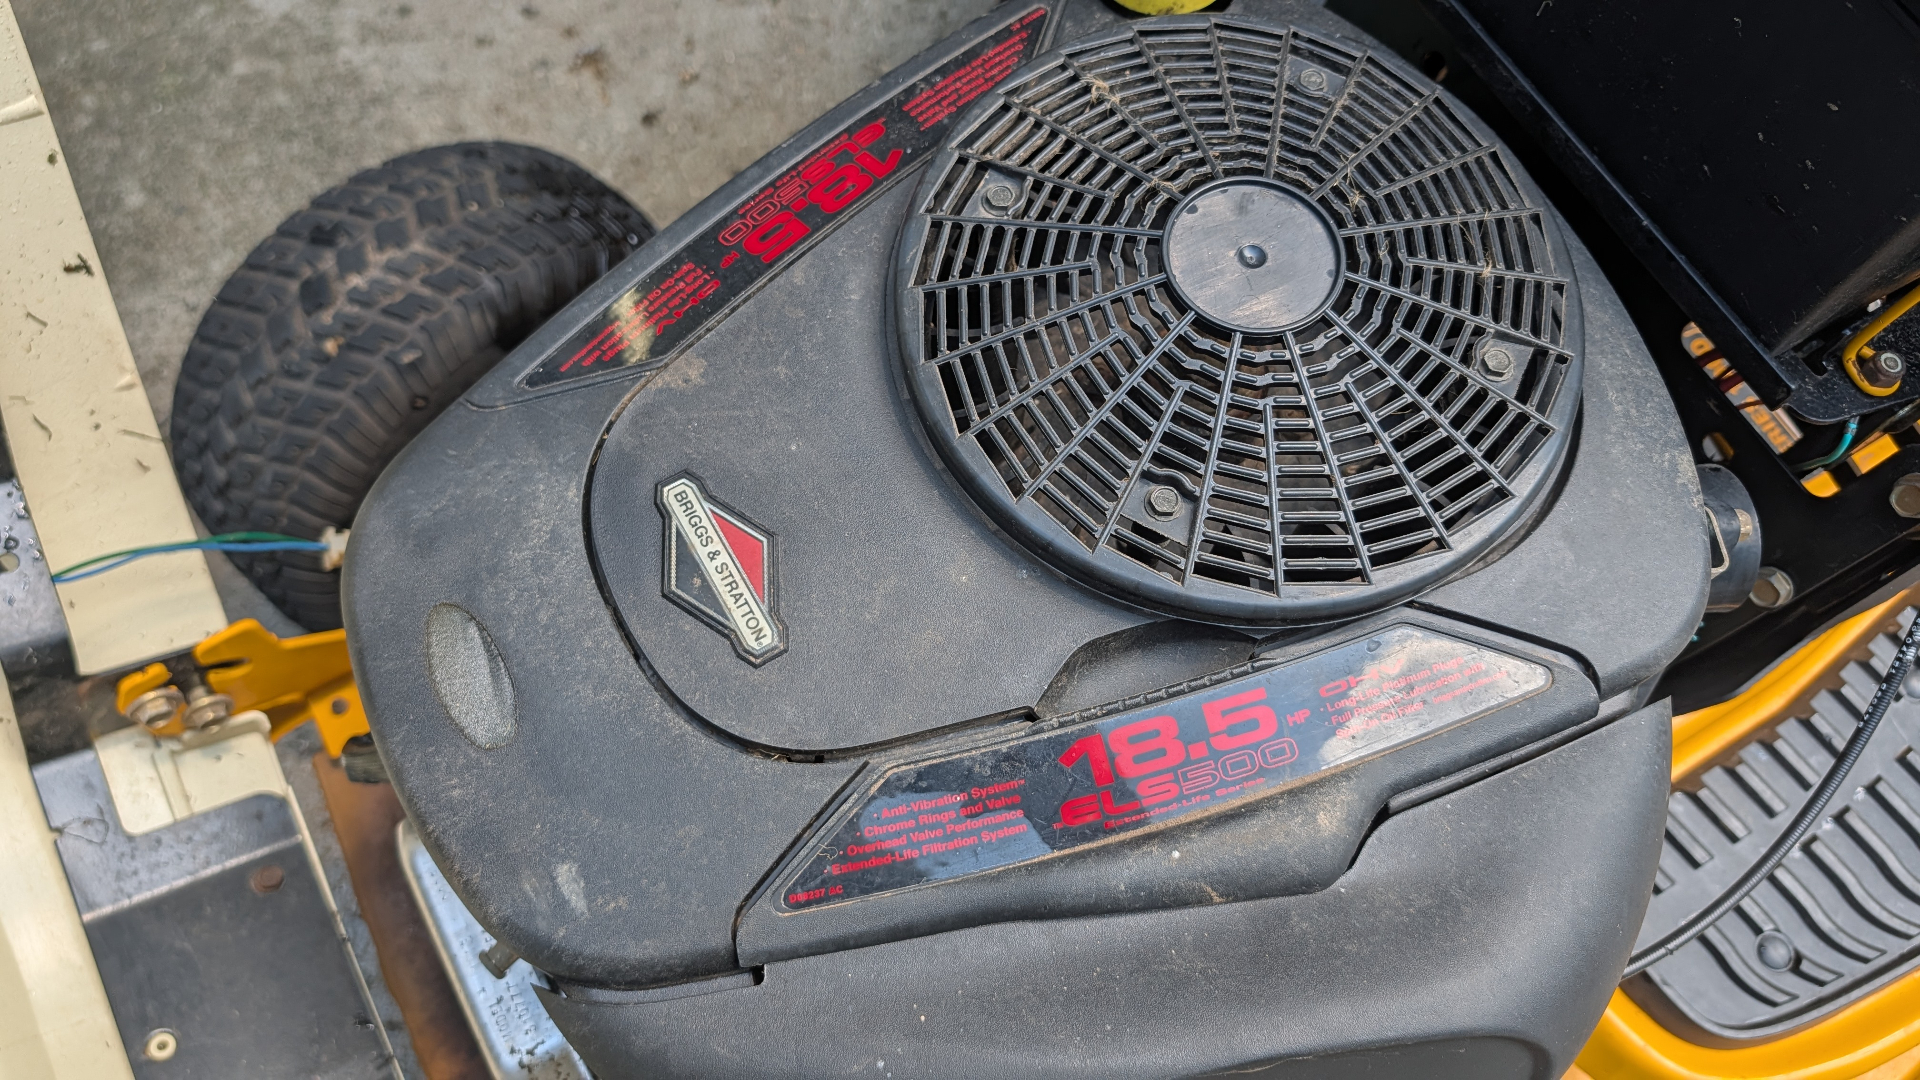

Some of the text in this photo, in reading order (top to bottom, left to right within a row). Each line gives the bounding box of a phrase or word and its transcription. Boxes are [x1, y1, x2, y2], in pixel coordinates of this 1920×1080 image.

[903, 31, 1027, 111] Extended-Life Filtration System
[910, 43, 1023, 116] Overhead Valve Performance
[918, 56, 1018, 122] Chrome Rings and Valve
[720, 136, 903, 268] 18.5 HP
[647, 289, 661, 301] Oil
[647, 281, 687, 312] Pressure
[660, 262, 695, 290] Spin-On
[684, 268, 703, 284] Full
[602, 274, 710, 361] Long-Life Platinum Plugs
[656, 279, 720, 335] OHV
[582, 350, 602, 366] with
[674, 490, 714, 548] BRIGGS
[707, 549, 720, 561] &
[1319, 659, 1405, 698] OHV
[1326, 656, 1464, 712] Long-Life Platinum Plugs
[1331, 663, 1485, 726] Full Pressure Lubrication with
[1058, 687, 1311, 787] 18.5 HP
[1336, 701, 1424, 740] Spin-On Oil Filter
[881, 793, 968, 819] Anti-Vibration
[1060, 738, 1298, 826] ELS500
[1104, 777, 1265, 829] Extended-Life Series
[847, 810, 1024, 856] Overhead Valve Performance
[864, 794, 1021, 838] Chrome Rings and Valve
[832, 824, 1027, 875] Extended-Life Filtration System
[829, 885, 843, 896] AC
